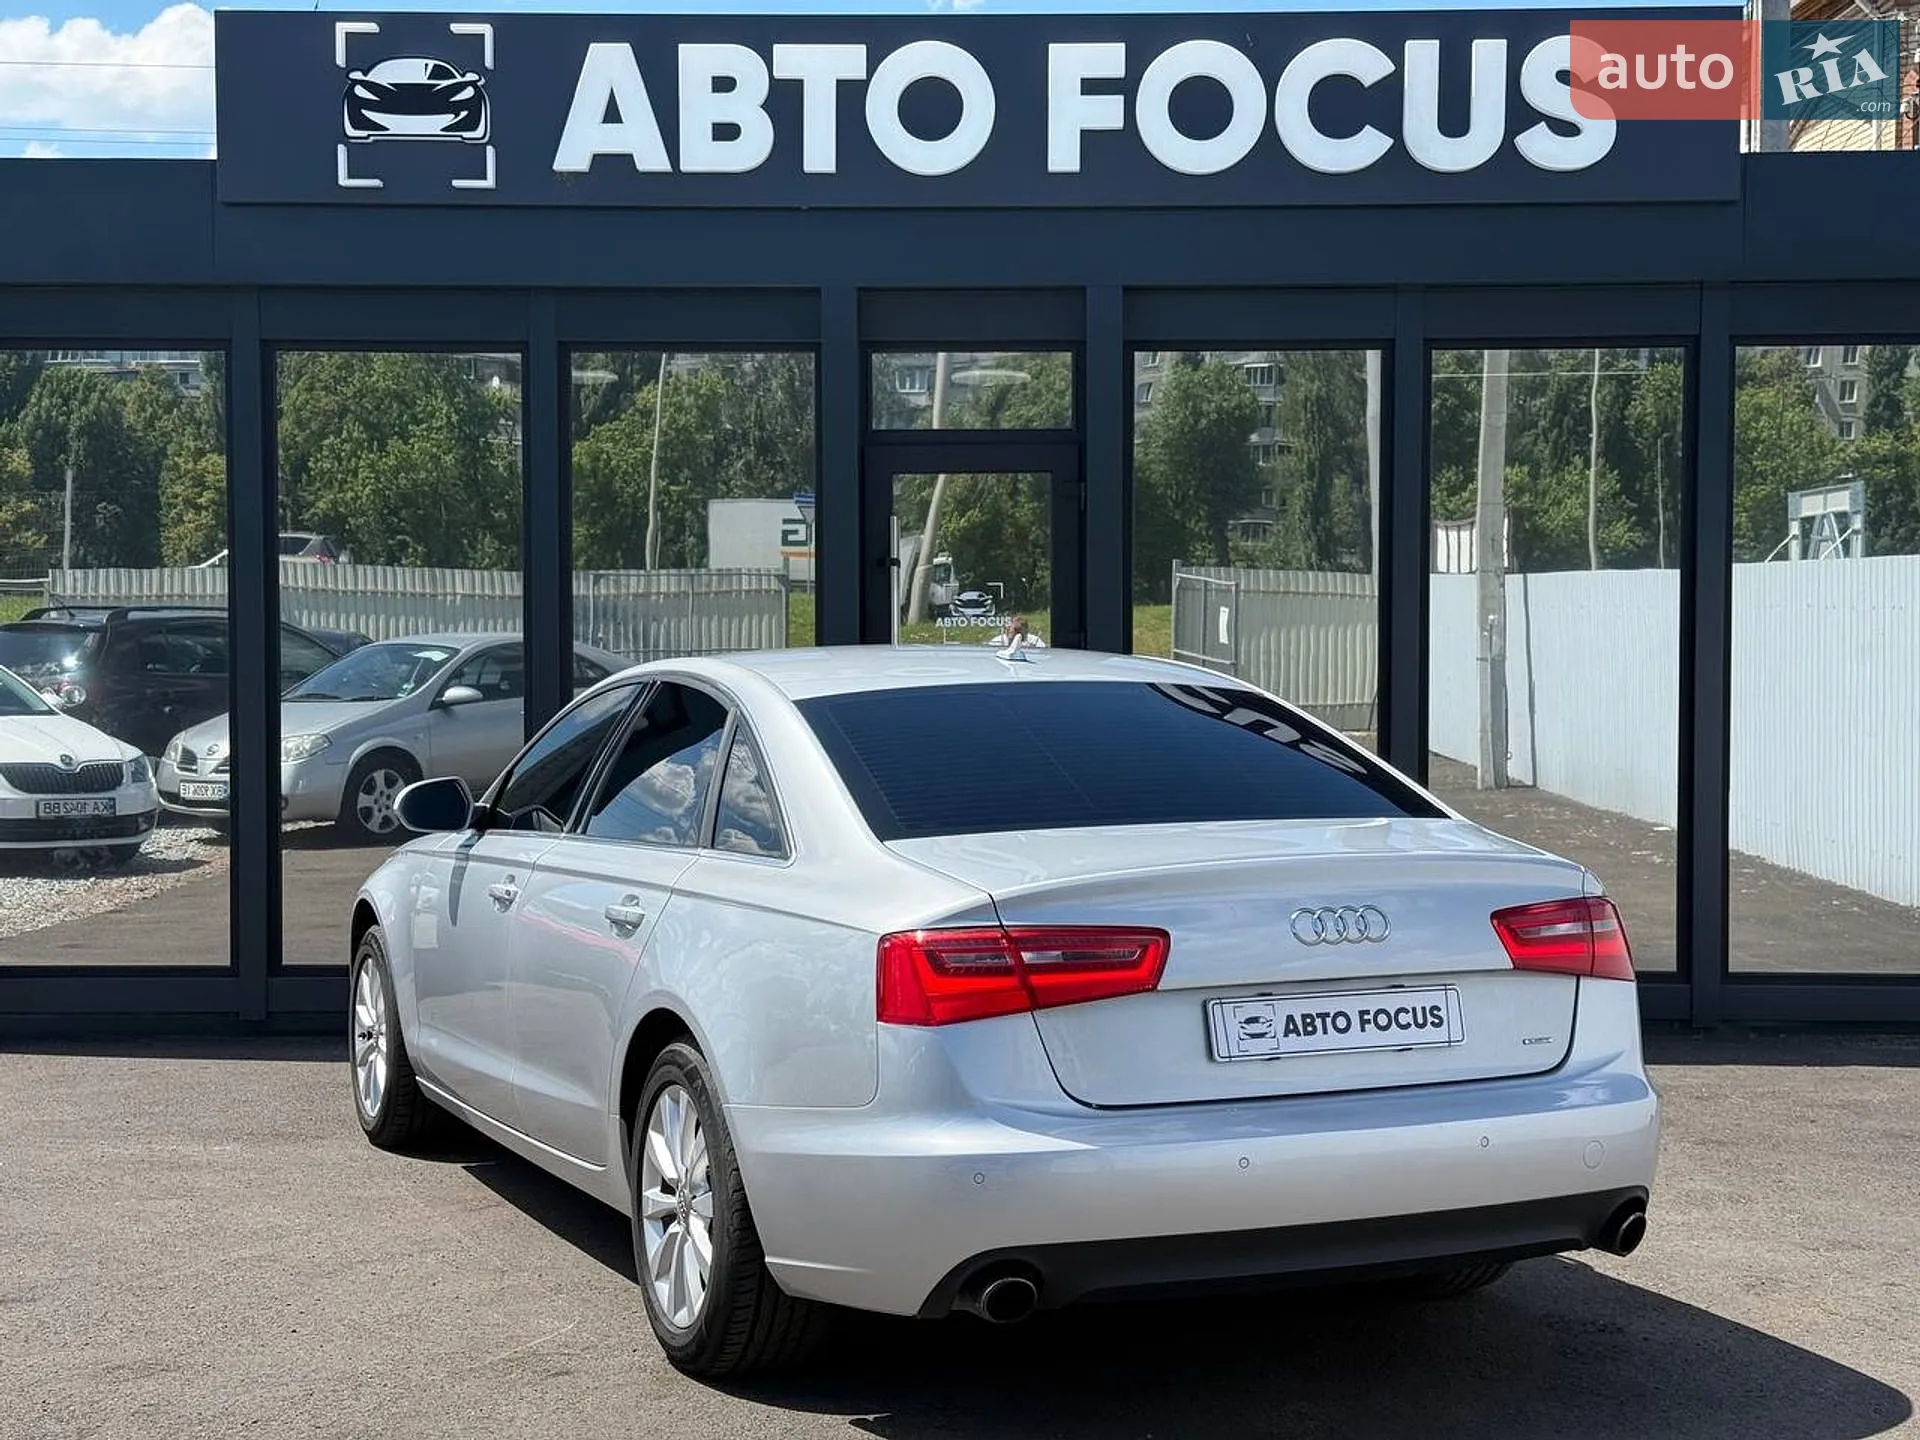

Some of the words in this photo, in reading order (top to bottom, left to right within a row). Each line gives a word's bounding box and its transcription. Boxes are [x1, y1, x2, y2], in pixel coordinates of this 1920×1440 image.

[1047, 35, 1617, 175] FOCUS
[970, 616, 1012, 628] FOCUS
[1358, 1005, 1444, 1033] FOCUS
